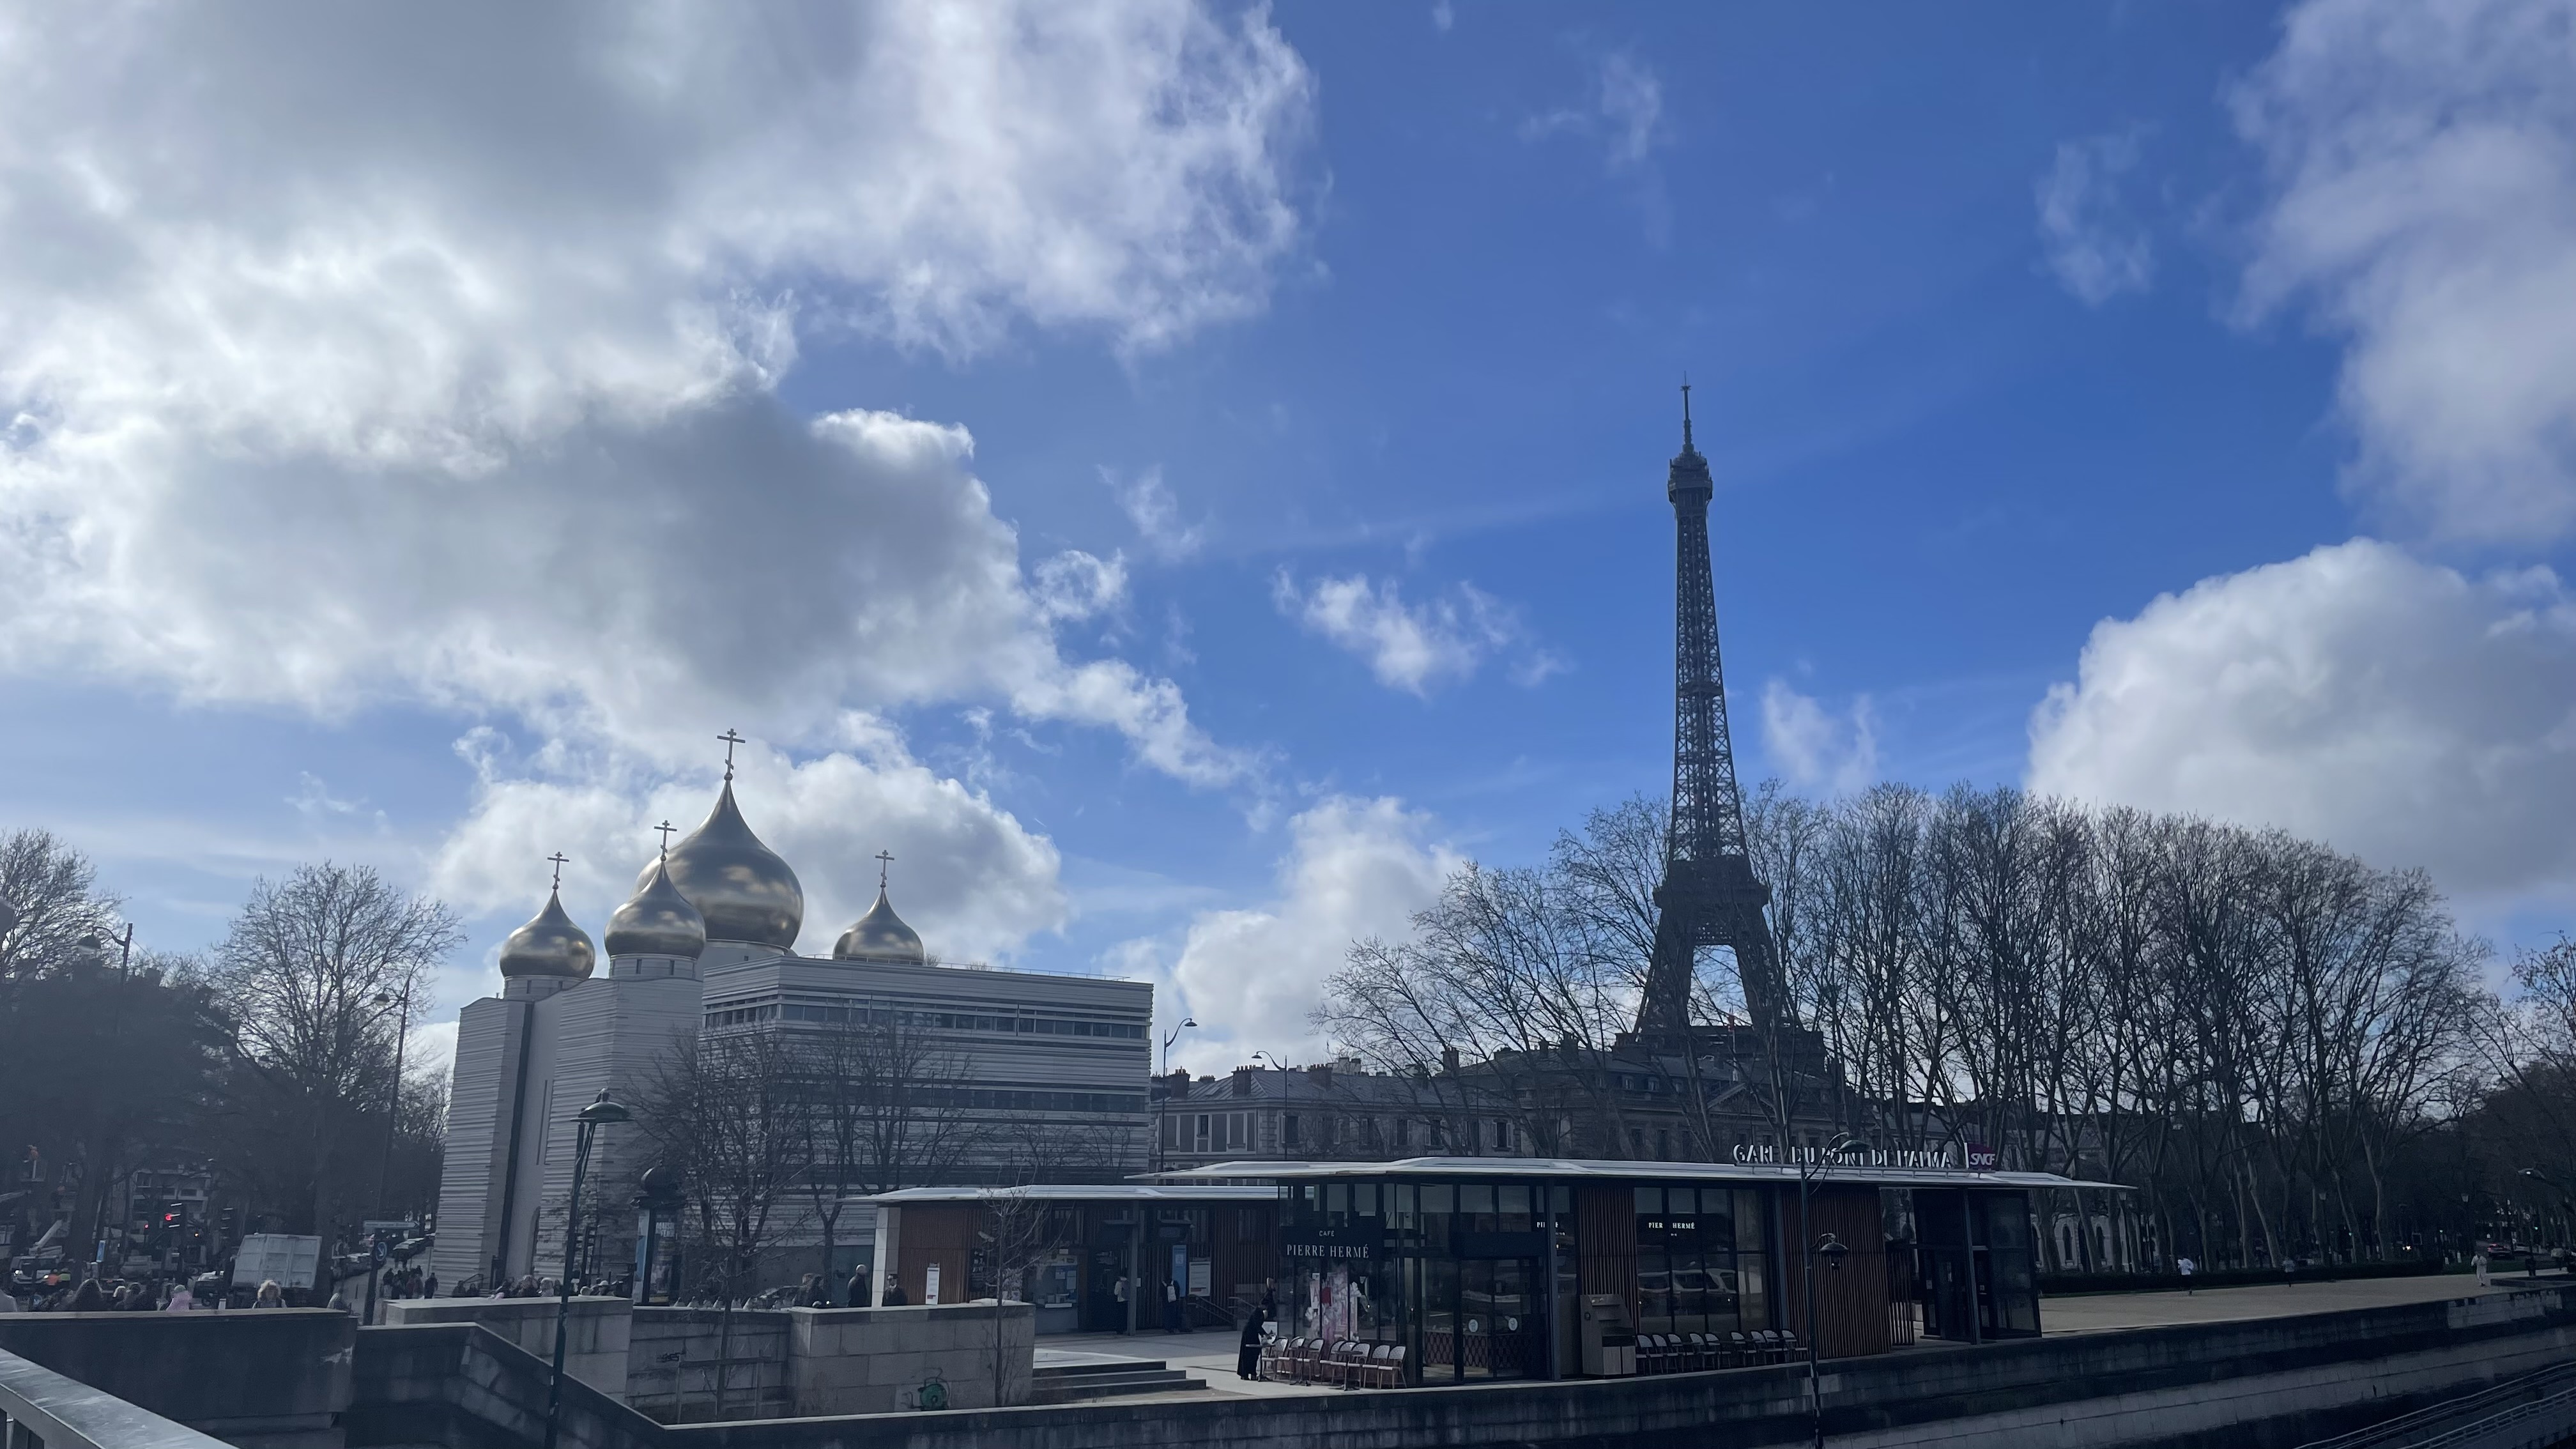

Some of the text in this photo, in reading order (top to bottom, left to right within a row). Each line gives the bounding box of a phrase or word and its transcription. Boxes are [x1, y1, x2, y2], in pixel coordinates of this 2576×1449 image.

[1791, 1146, 1815, 1163] DU
[1969, 1153, 1995, 1165] SNCF
[1287, 1243, 1369, 1259] PIERRE HERMÉ
